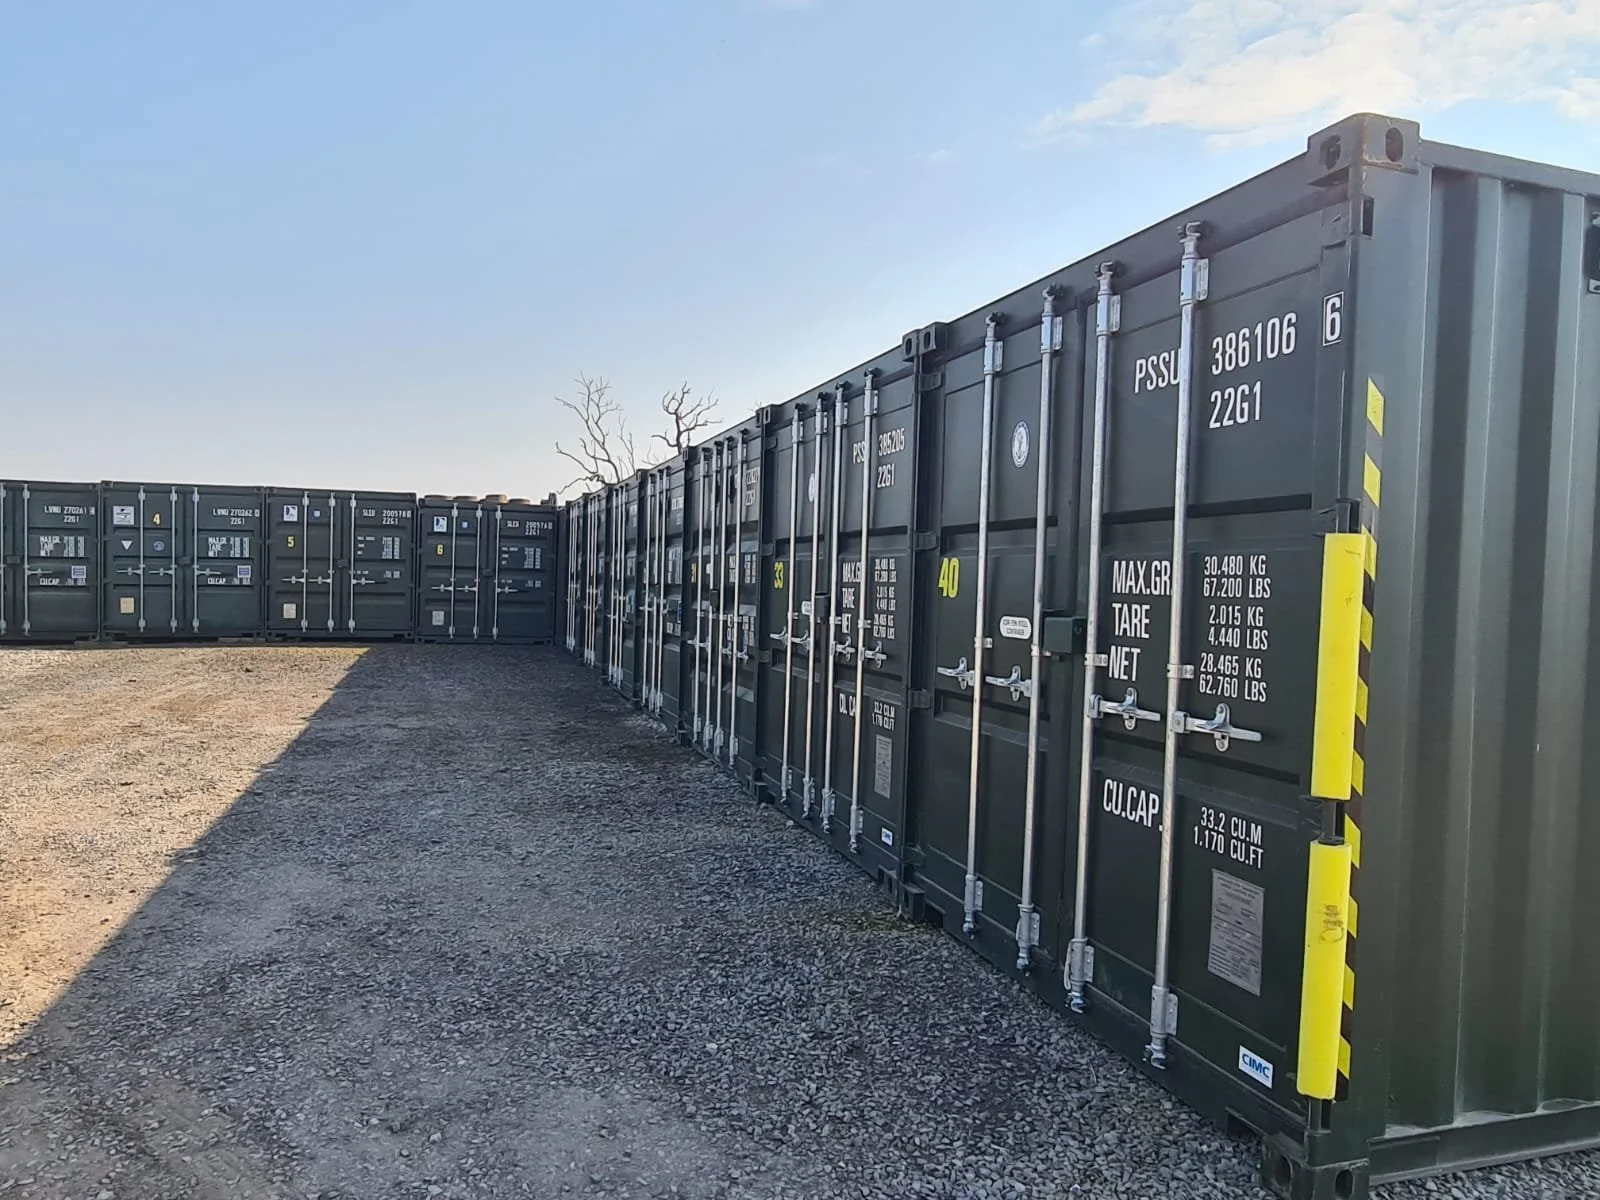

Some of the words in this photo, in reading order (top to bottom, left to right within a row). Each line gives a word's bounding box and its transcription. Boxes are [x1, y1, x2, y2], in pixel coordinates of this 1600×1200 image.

[1211, 313, 1296, 376] 386106
[1325, 297, 1341, 342] 6
[1209, 380, 1262, 429] 22G1
[877, 463, 895, 488] 22G1
[153, 513, 161, 525] 4
[287, 536, 295, 548] 5
[437, 544, 444, 555] 6
[774, 561, 785, 589] 33
[1249, 555, 1267, 576] KG
[938, 557, 960, 598] 40
[1248, 578, 1271, 598] LBS
[842, 587, 855, 609] TARE
[841, 613, 852, 633] NET
[1112, 603, 1151, 639] TARE
[1247, 606, 1264, 627] KG
[1246, 629, 1269, 650] LBS
[1109, 645, 1142, 681] NET
[1245, 657, 1263, 679] KG
[1244, 684, 1268, 702] LBS
[1200, 806, 1226, 833] 33.2
[1230, 816, 1263, 846] CU.M
[1193, 826, 1225, 855] 1.170
[1230, 838, 1265, 869] CU.FT
[1242, 1053, 1271, 1079] CIMC
